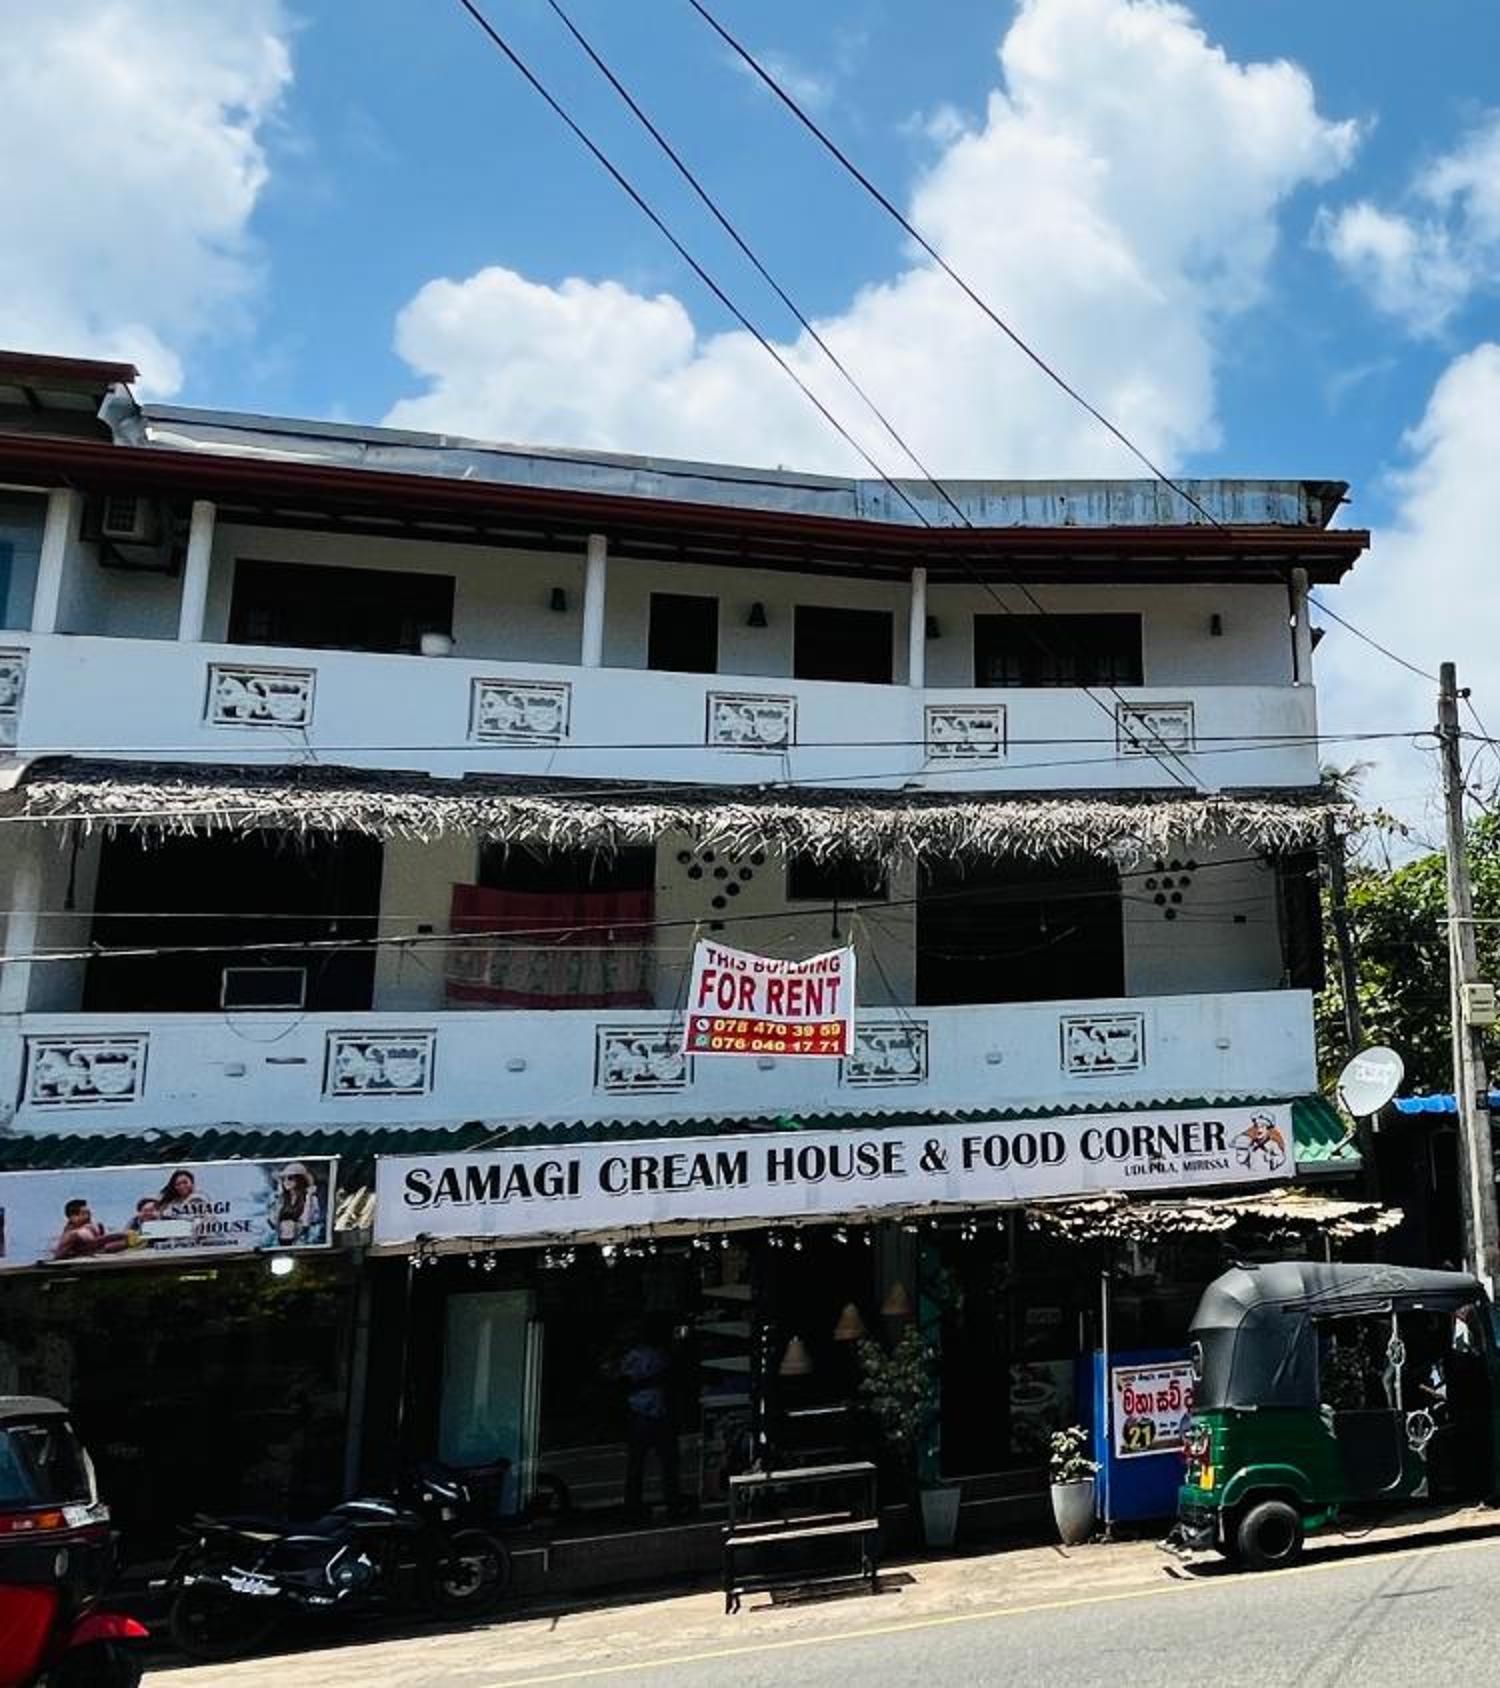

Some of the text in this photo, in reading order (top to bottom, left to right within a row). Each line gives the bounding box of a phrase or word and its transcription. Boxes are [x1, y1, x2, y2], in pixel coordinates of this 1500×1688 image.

[706, 948, 747, 971] THIS
[698, 969, 841, 1016] FOR RENT
[754, 1022, 787, 1035] 470
[711, 1036, 746, 1050] 076
[751, 1038, 785, 1051] 040
[820, 1040, 839, 1051] 71
[403, 1121, 1228, 1208] SAMAGI CREAM HOUSE & FOOD CORNER
[171, 1201, 230, 1216] SAMAGI
[1129, 1424, 1152, 1450] 21
